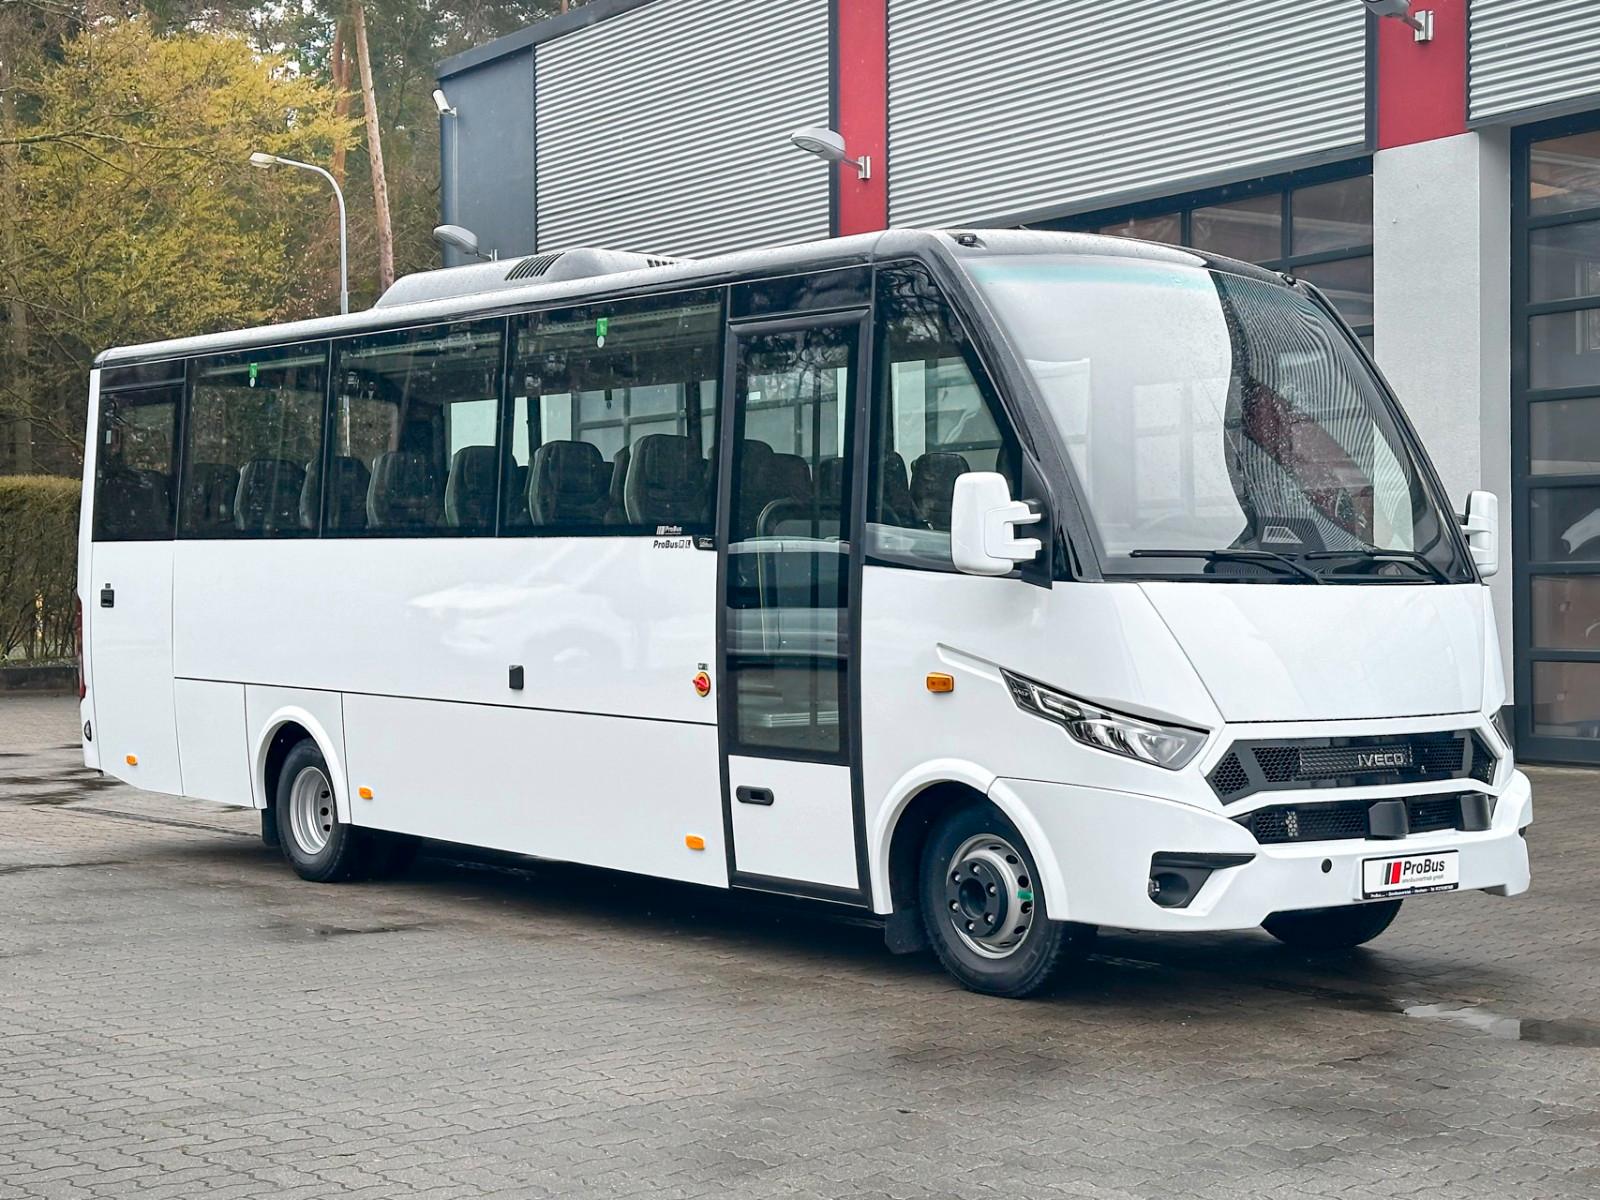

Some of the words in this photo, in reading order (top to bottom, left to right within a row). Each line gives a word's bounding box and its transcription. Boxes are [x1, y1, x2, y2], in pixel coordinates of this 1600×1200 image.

[653, 540, 678, 549] ProBus
[1357, 753, 1404, 766] IVECO
[1403, 859, 1445, 875] ProBus
